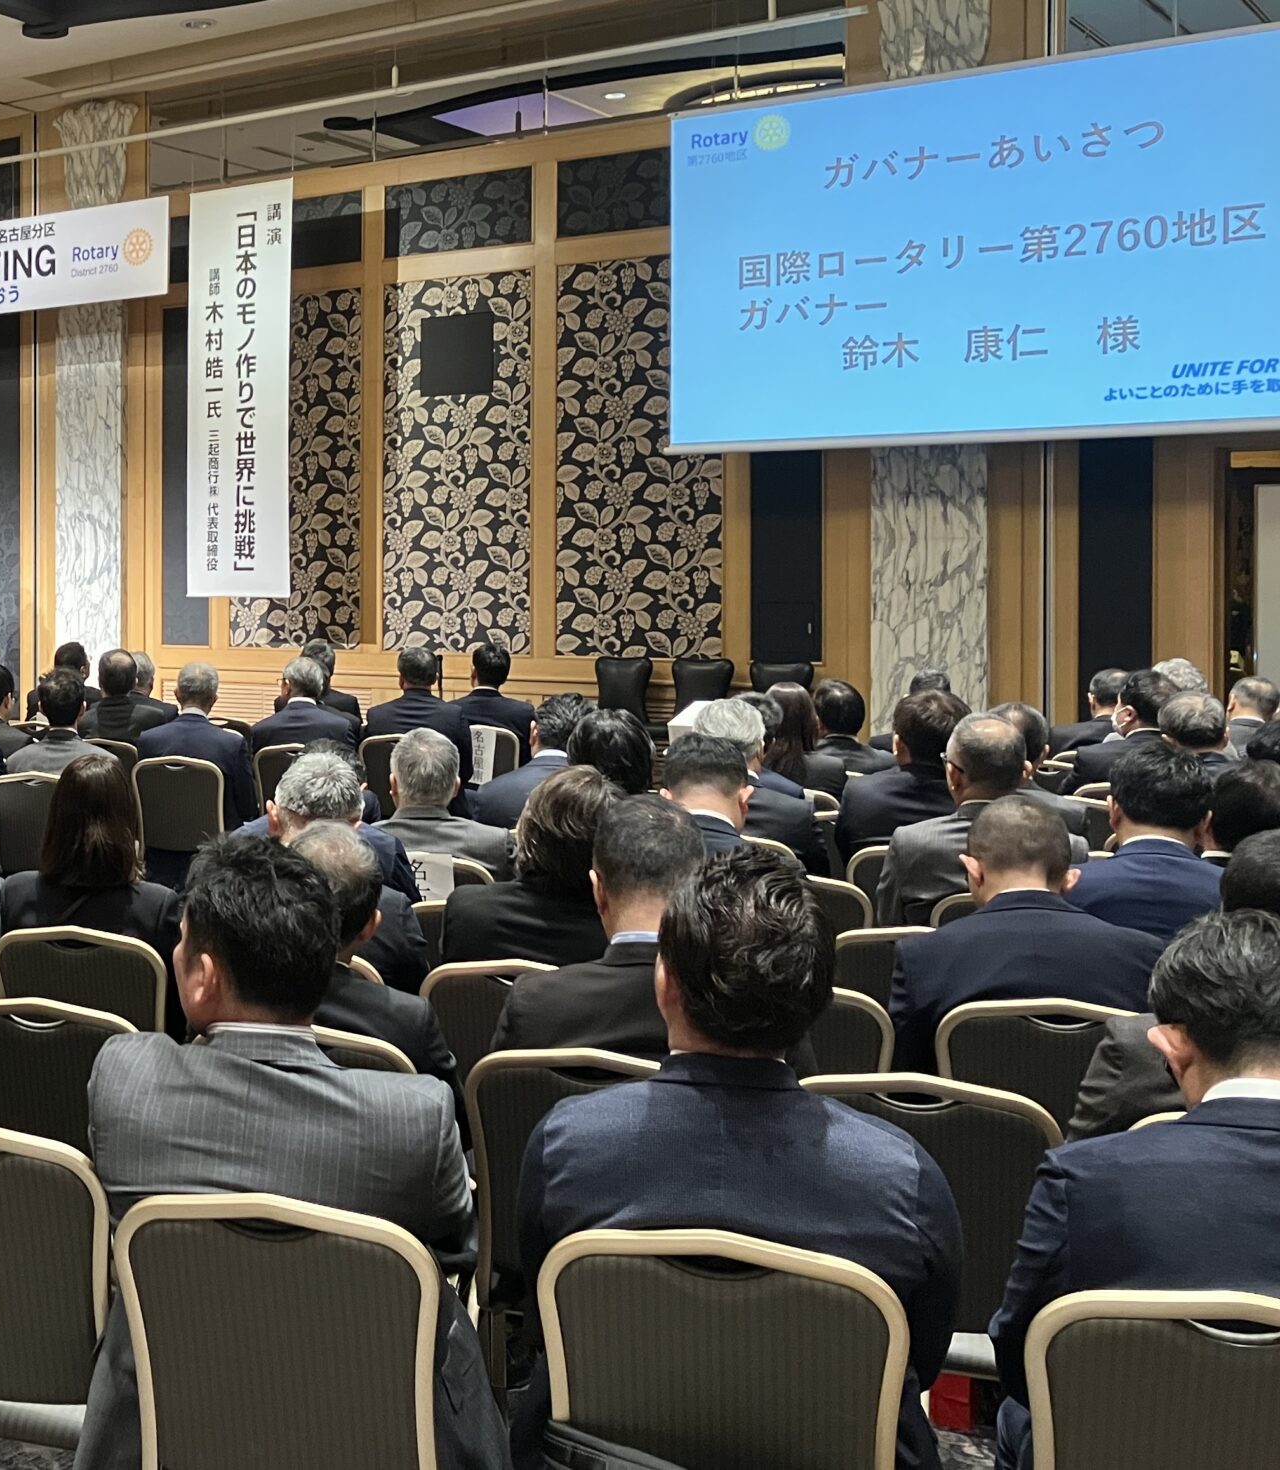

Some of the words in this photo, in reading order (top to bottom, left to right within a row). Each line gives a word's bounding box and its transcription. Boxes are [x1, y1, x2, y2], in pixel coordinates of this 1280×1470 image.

[690, 130, 749, 150] Rotary
[823, 118, 1166, 190] ガバナーあいさつ
[72, 244, 120, 262] Rotary
[737, 202, 1268, 291] 国際ロータリー第2760地区
[70, 266, 97, 278] District
[98, 263, 119, 275] 2760
[738, 292, 889, 332] ガバナー
[841, 331, 921, 372] 鈴木
[963, 323, 1049, 364] 康仁
[1096, 315, 1142, 355] 様
[1171, 360, 1234, 379] UNITE
[1236, 358, 1280, 376] FOR
[233, 210, 258, 572] 「日本のモノ作りで世界に挑戦」
